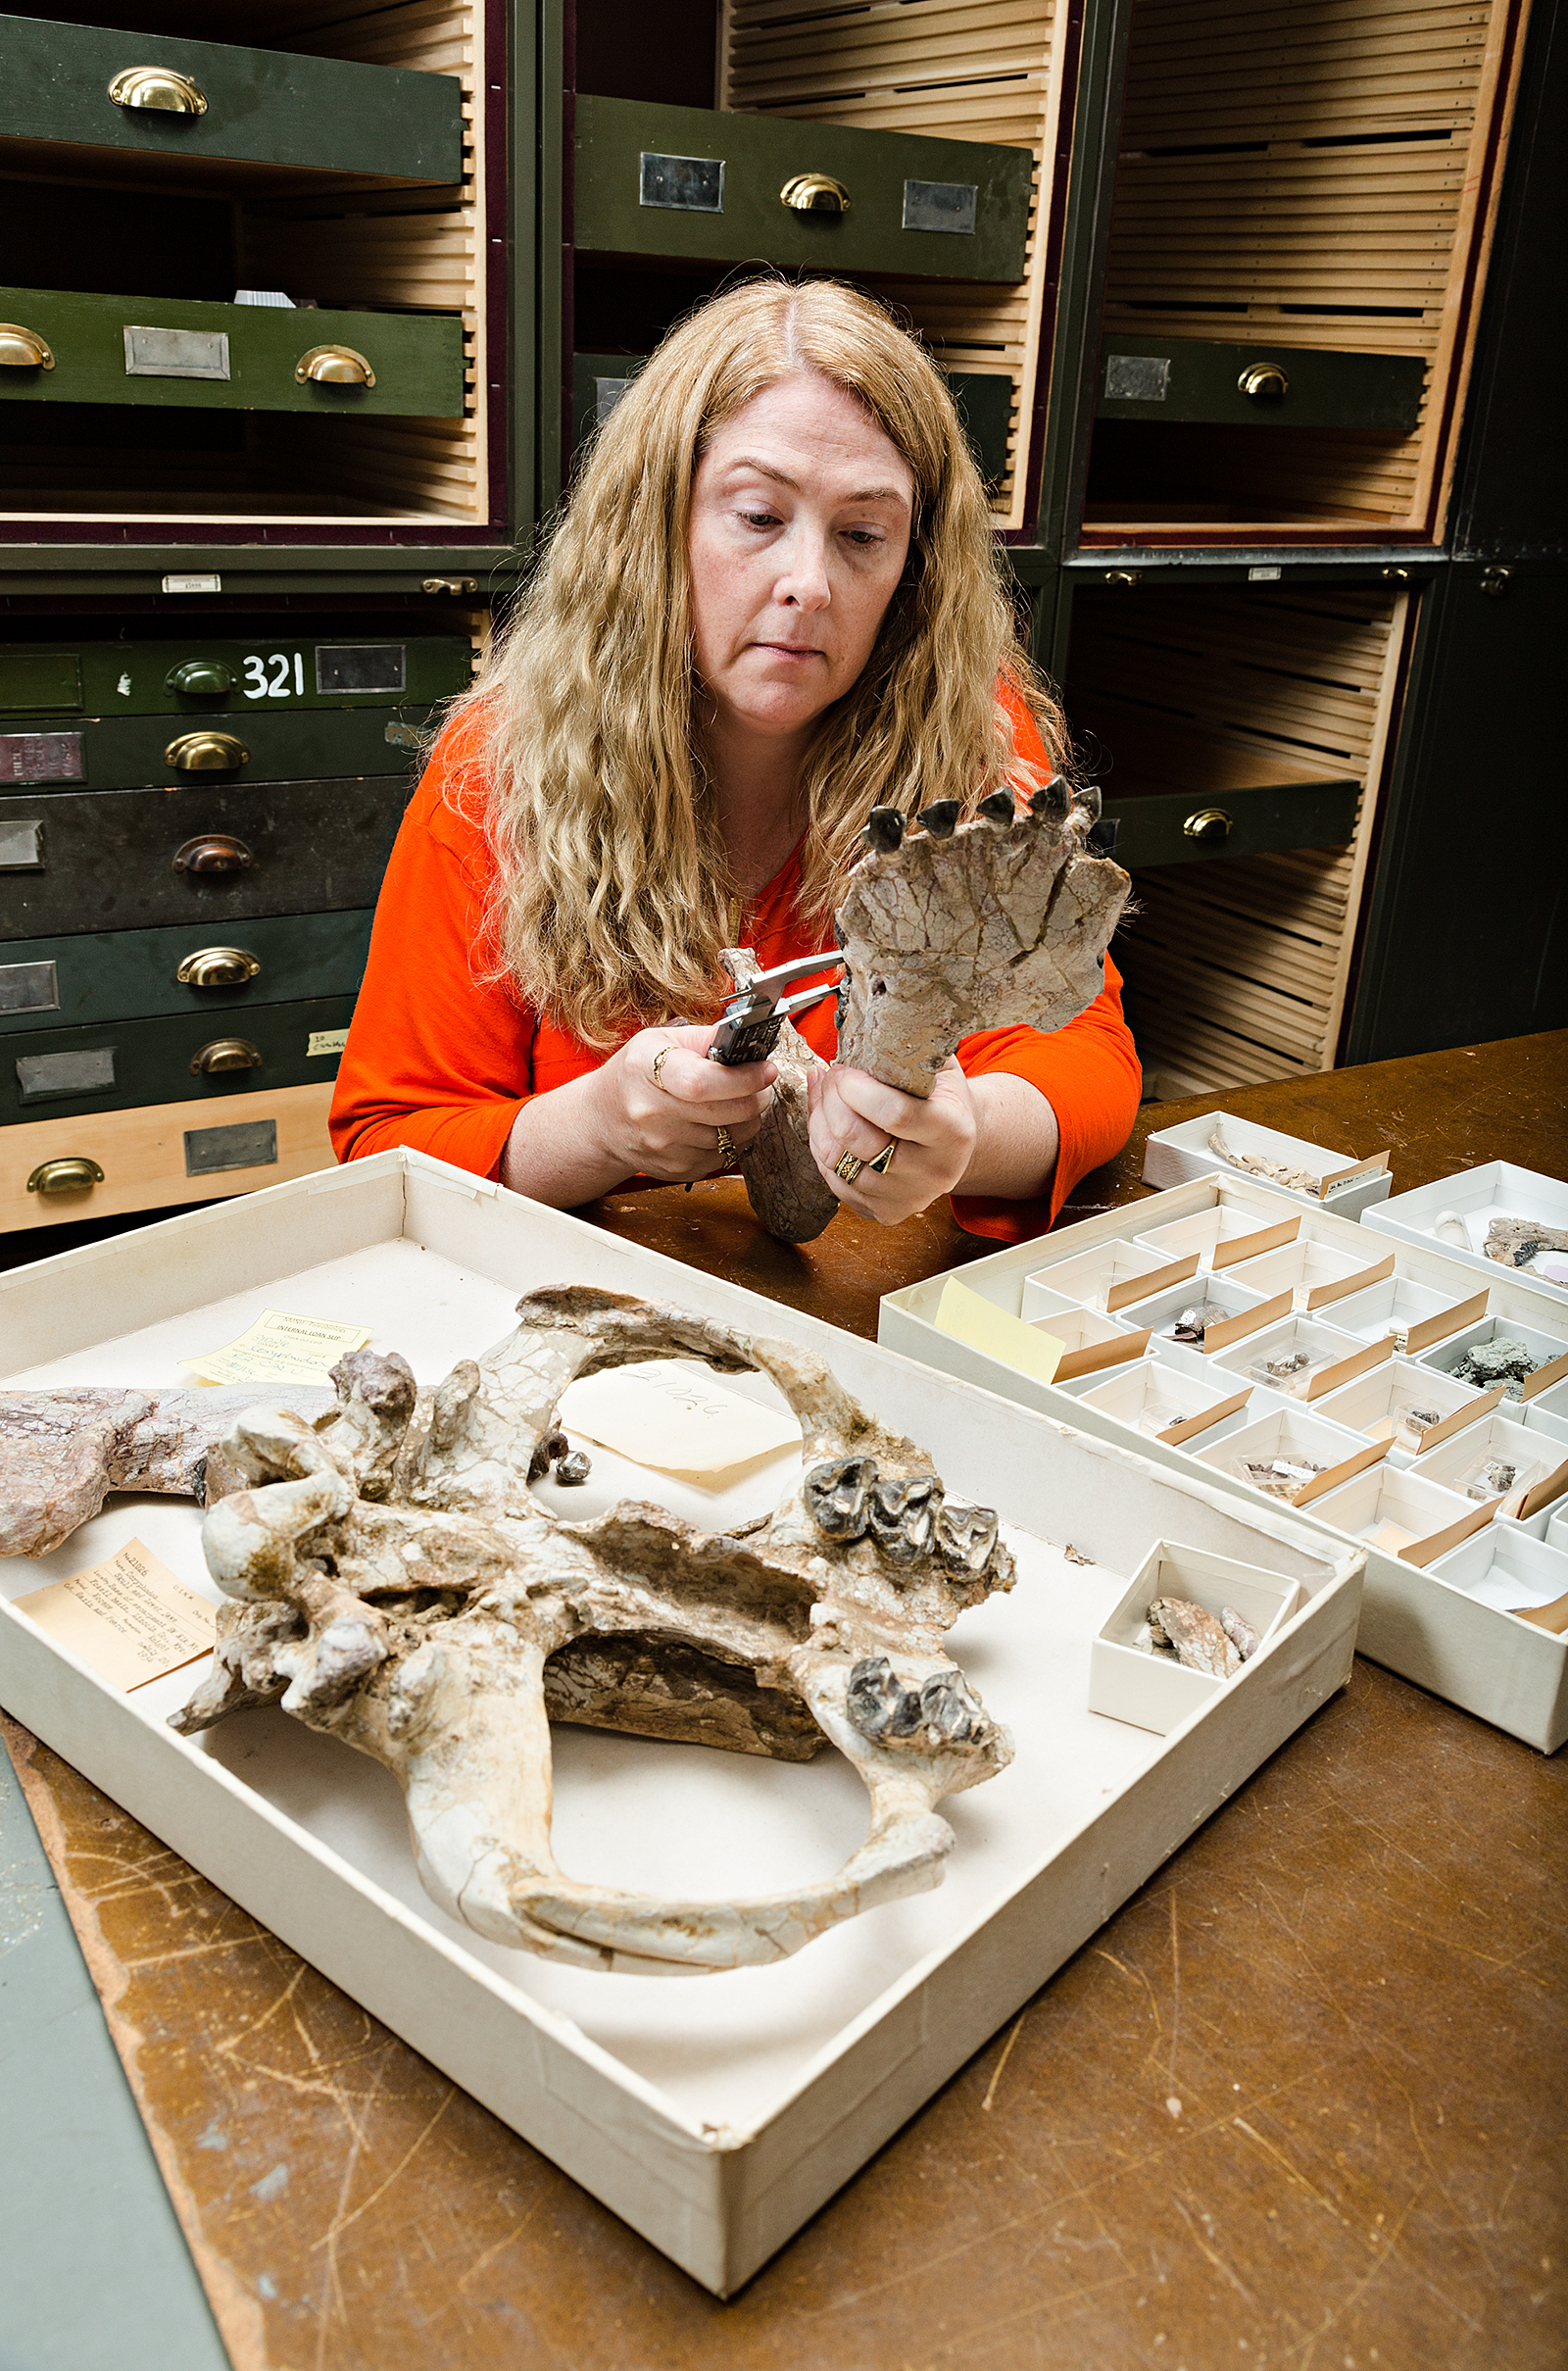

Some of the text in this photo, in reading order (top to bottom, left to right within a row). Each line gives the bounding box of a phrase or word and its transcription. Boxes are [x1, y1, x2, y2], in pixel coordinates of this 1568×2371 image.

[242, 652, 304, 700] 321
[251, 1333, 290, 1347] 21026
[276, 1324, 311, 1337] INTERNAL
[310, 1330, 327, 1339] LOAN
[619, 1368, 727, 1415] 21026
[127, 1556, 149, 1577] 21026
[90, 1578, 112, 1598] Fossil
[114, 1572, 133, 1590] Skull
[132, 1604, 167, 1627] escarpment
